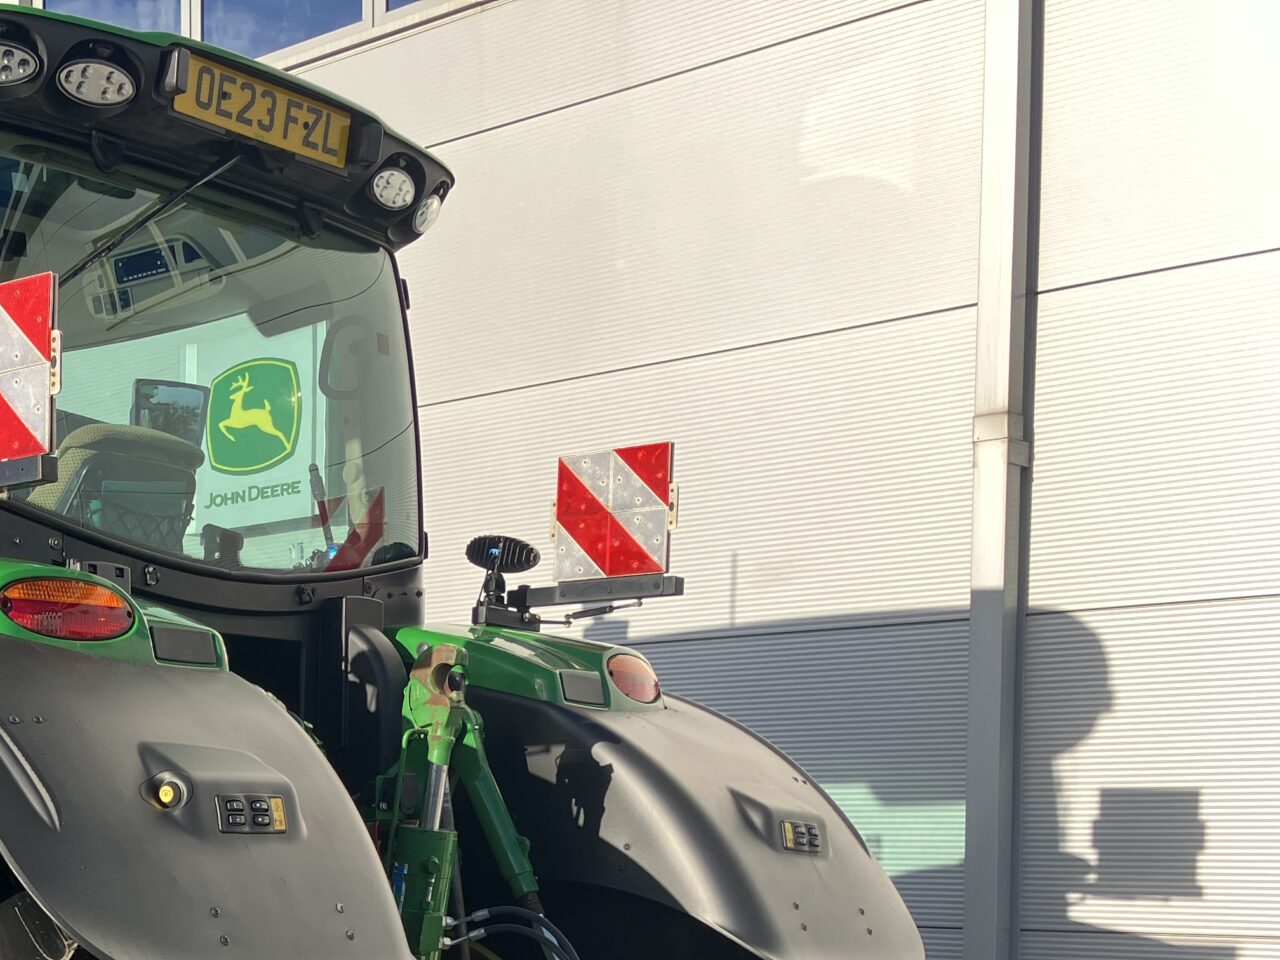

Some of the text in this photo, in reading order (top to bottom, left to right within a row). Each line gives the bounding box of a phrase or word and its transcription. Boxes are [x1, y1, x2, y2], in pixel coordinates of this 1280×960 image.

[195, 65, 339, 157] OE23 FZL
[204, 481, 302, 509] JOHN DEERE
